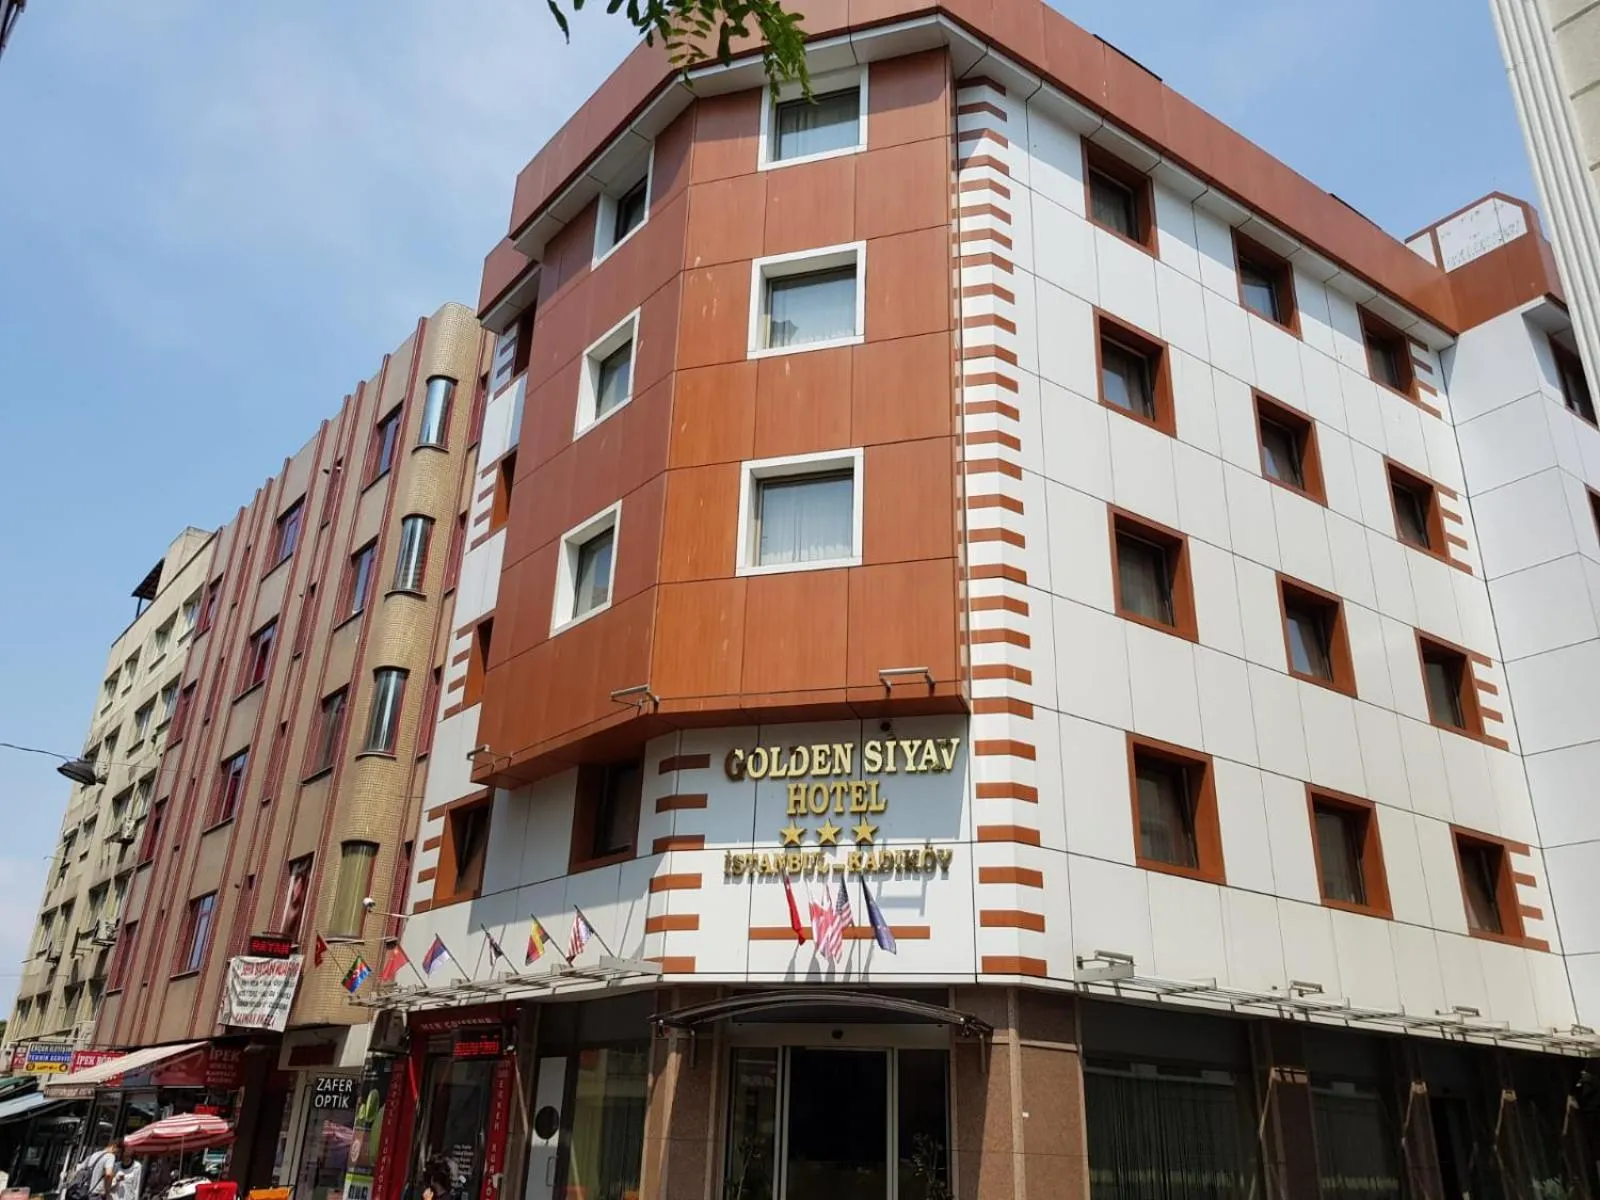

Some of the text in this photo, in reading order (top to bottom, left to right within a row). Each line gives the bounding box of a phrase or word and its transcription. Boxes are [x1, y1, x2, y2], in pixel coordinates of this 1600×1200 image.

[724, 743, 854, 781] GOLDEN
[786, 780, 888, 815] HOTEL
[316, 1077, 353, 1092] ZAFER
[314, 1093, 350, 1109] OPTİK
